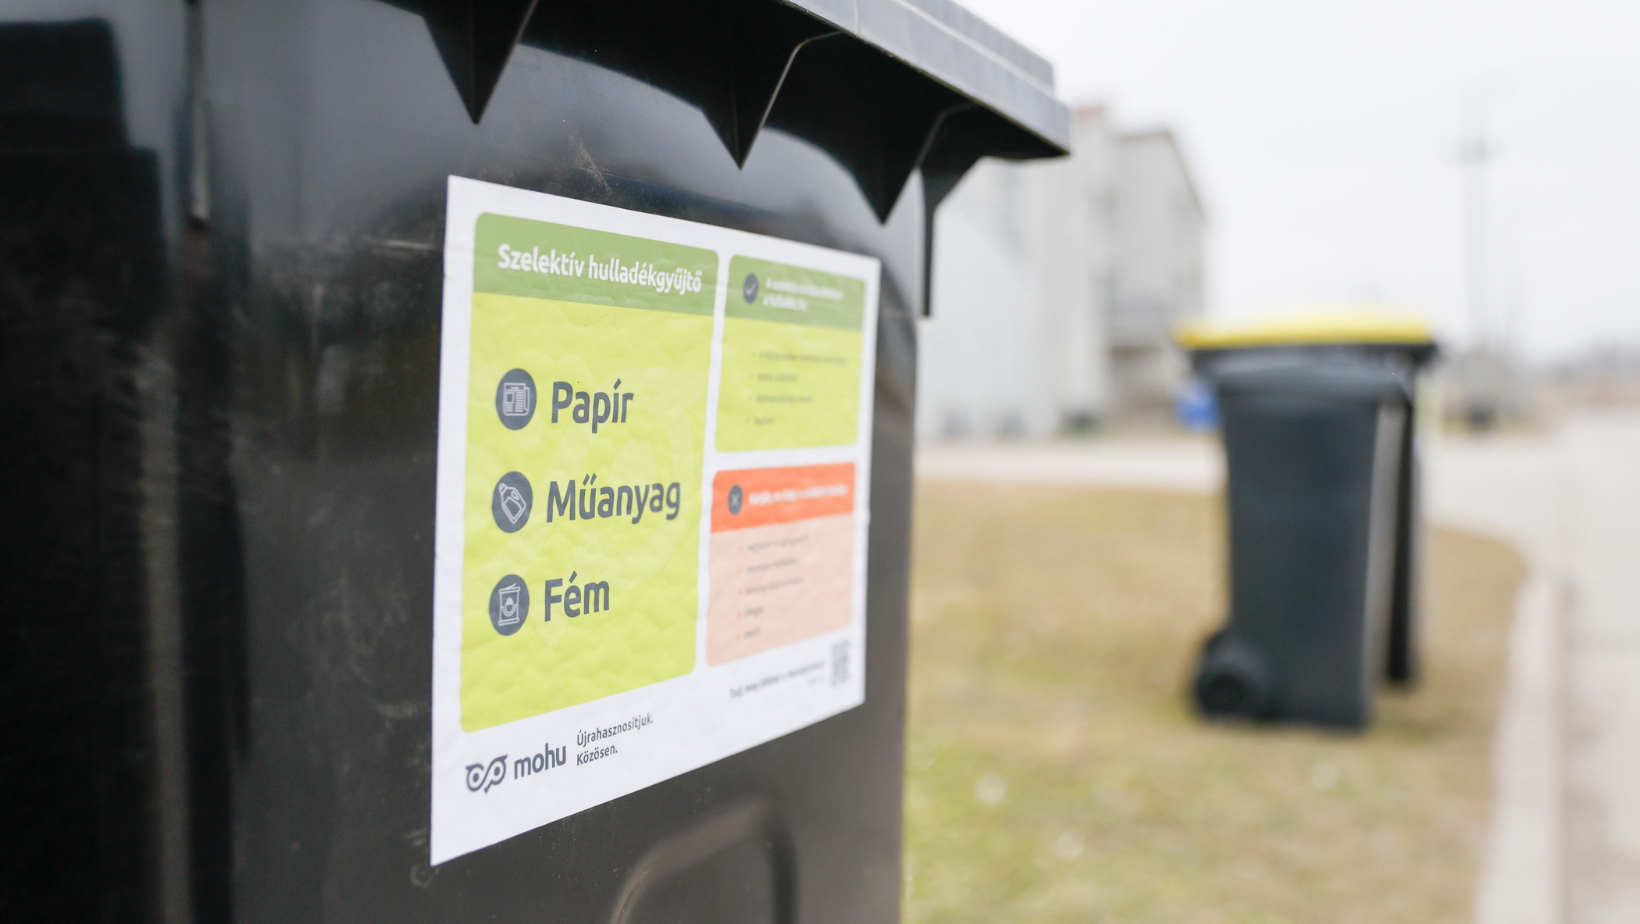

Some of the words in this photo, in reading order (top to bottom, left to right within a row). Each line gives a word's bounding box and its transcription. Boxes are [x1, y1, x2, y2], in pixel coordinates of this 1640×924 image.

[498, 243, 585, 277] Szelektív
[588, 254, 703, 296] hulladékgyűjtő
[551, 378, 634, 434] Papír
[546, 473, 681, 525] Műanyag
[544, 570, 610, 622] Fém
[576, 712, 655, 748] Újrahasznosítjuk.
[576, 744, 618, 766] Közösen.
[514, 743, 567, 780] mohu
